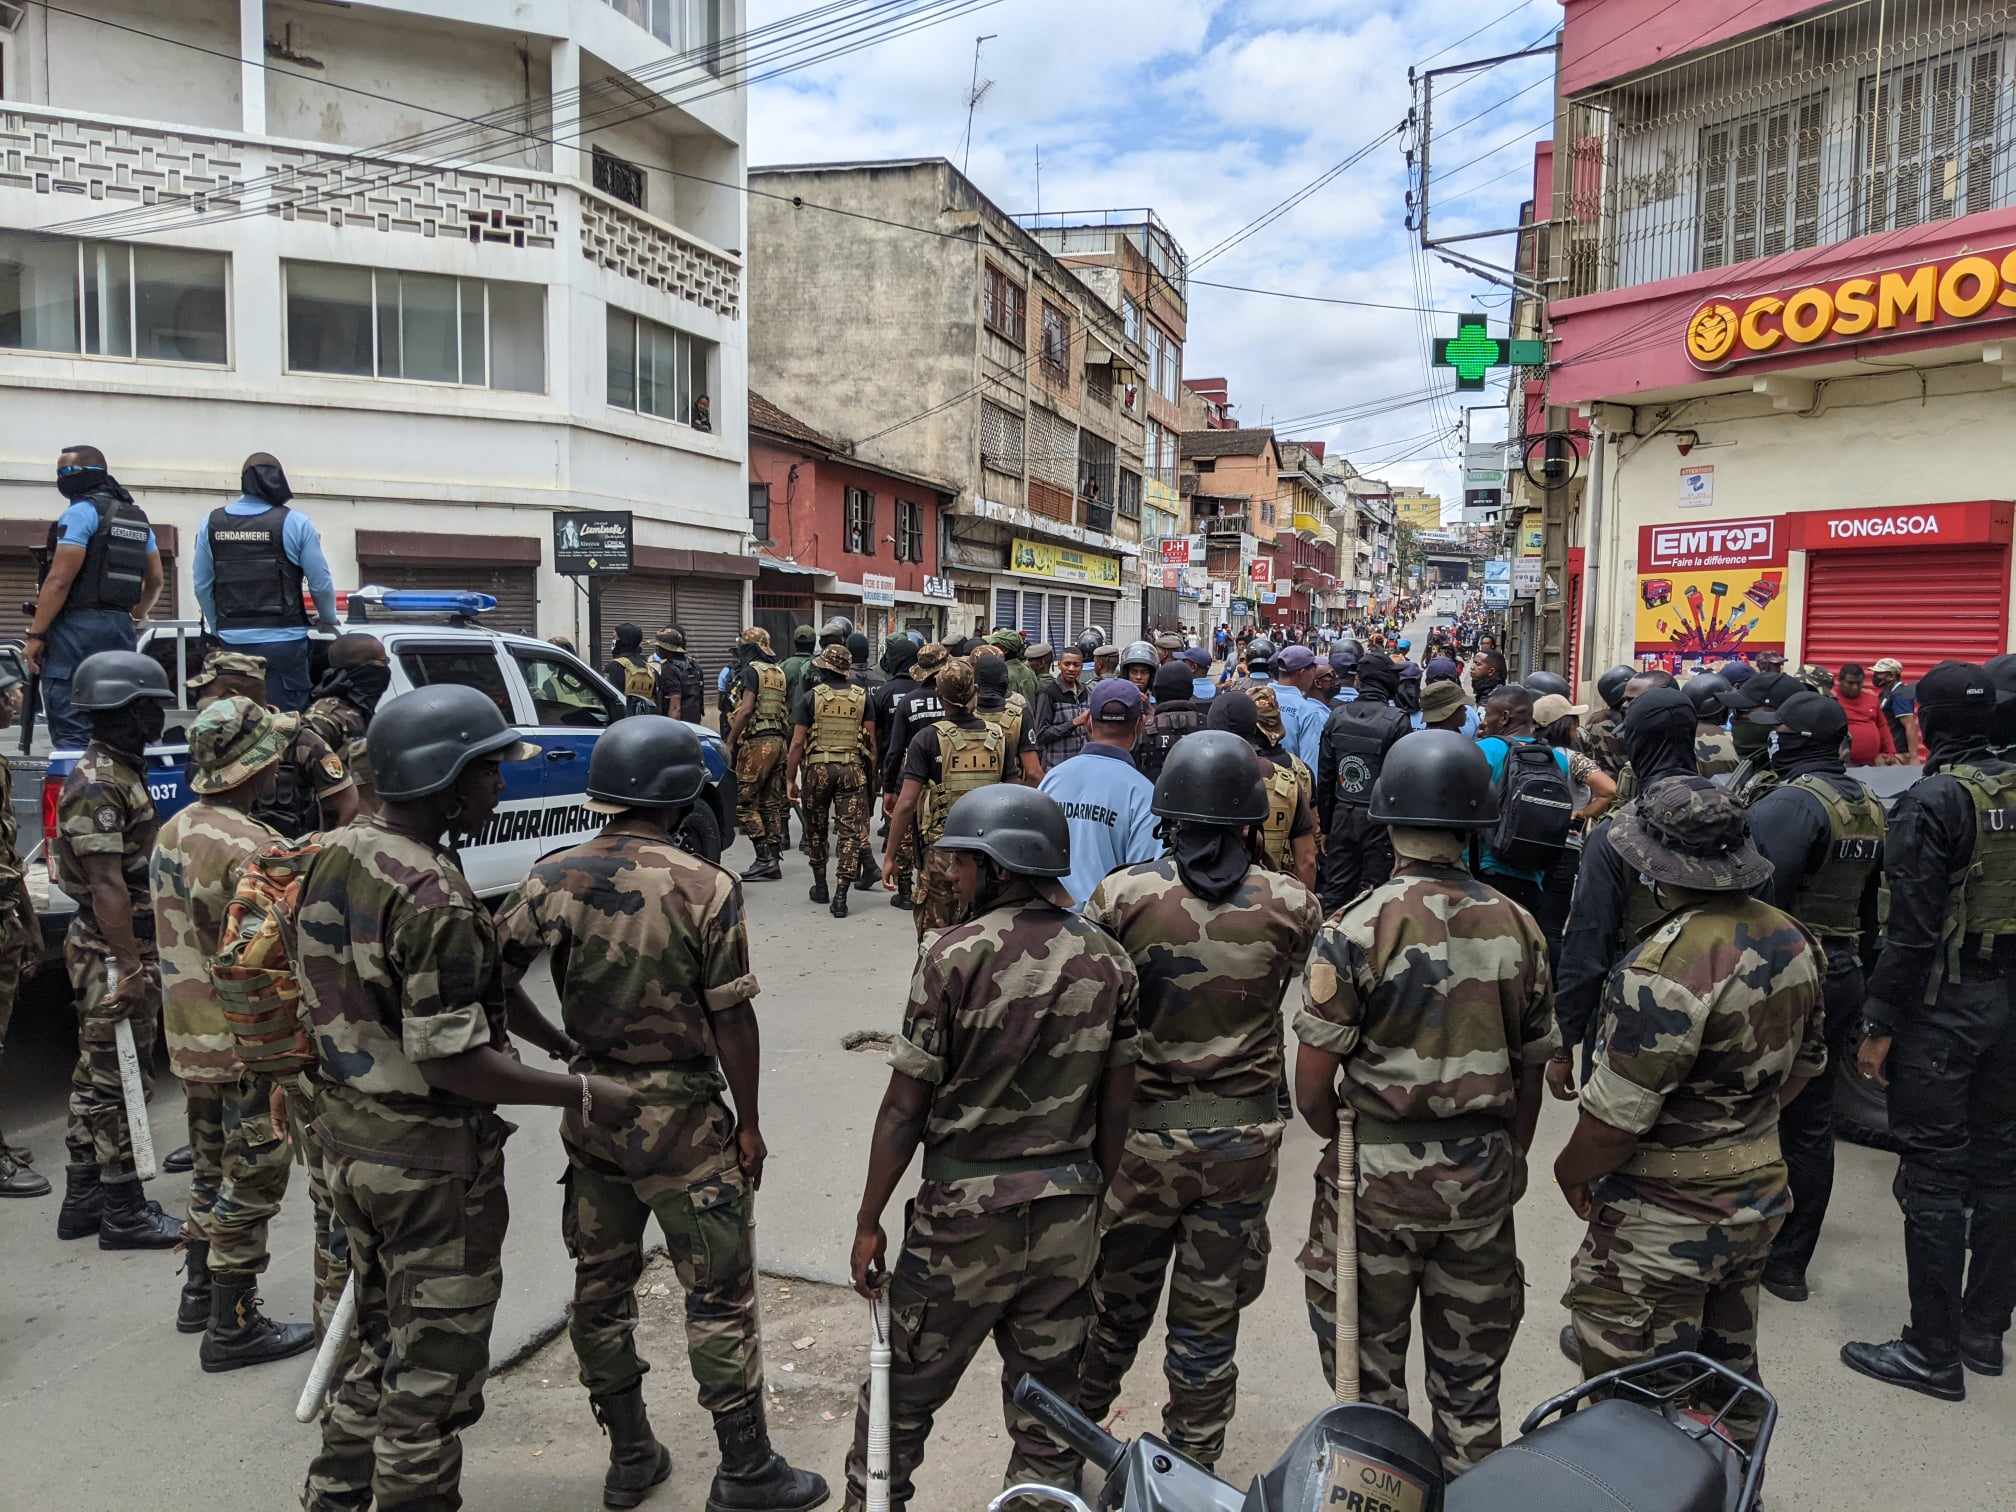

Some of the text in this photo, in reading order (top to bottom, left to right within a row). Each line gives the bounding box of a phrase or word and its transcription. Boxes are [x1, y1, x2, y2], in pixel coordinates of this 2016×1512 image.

[1827, 515, 1938, 538] TONGASOA
[215, 531, 270, 541] GENDARMERIE
[1656, 527, 1767, 555] EMTOP
[1671, 555, 1747, 567] Faire la différence
[823, 704, 857, 716] F.I.P
[952, 755, 997, 769] F.I.P
[147, 783, 177, 801] 037
[1344, 783, 1362, 792] USI
[1839, 839, 1879, 859] U.S.I
[1359, 1466, 1402, 1497] OJM
